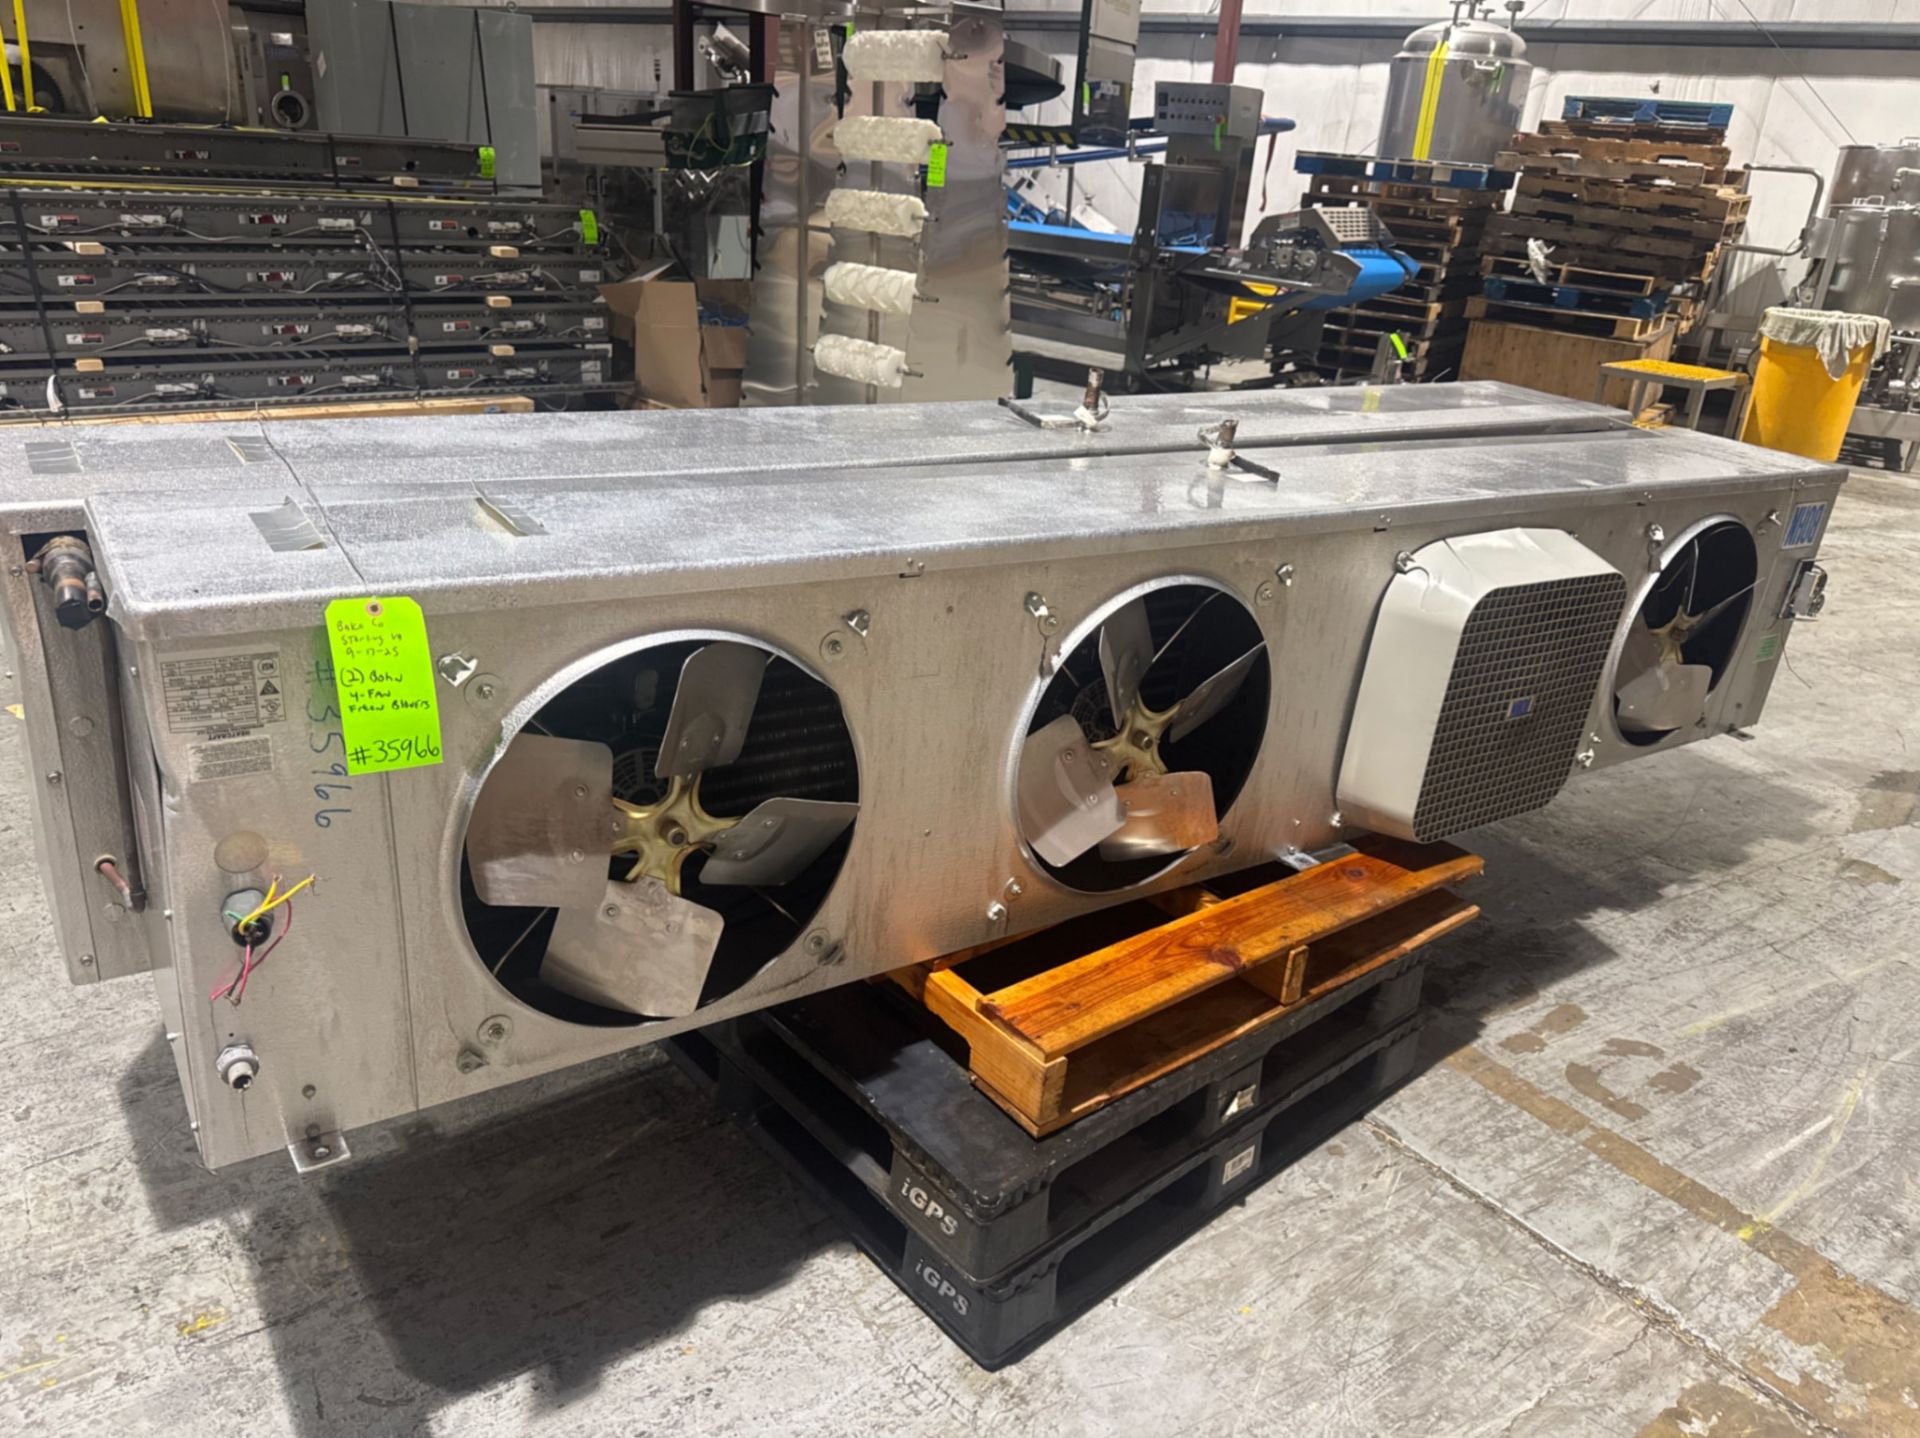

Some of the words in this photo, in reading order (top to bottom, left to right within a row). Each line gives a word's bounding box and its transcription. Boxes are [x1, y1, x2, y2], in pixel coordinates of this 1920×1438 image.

[340, 667, 365, 688] (2)
[348, 734, 440, 765] #35966
[901, 1177, 959, 1236] iGPS
[915, 1258, 970, 1317] iGPS
